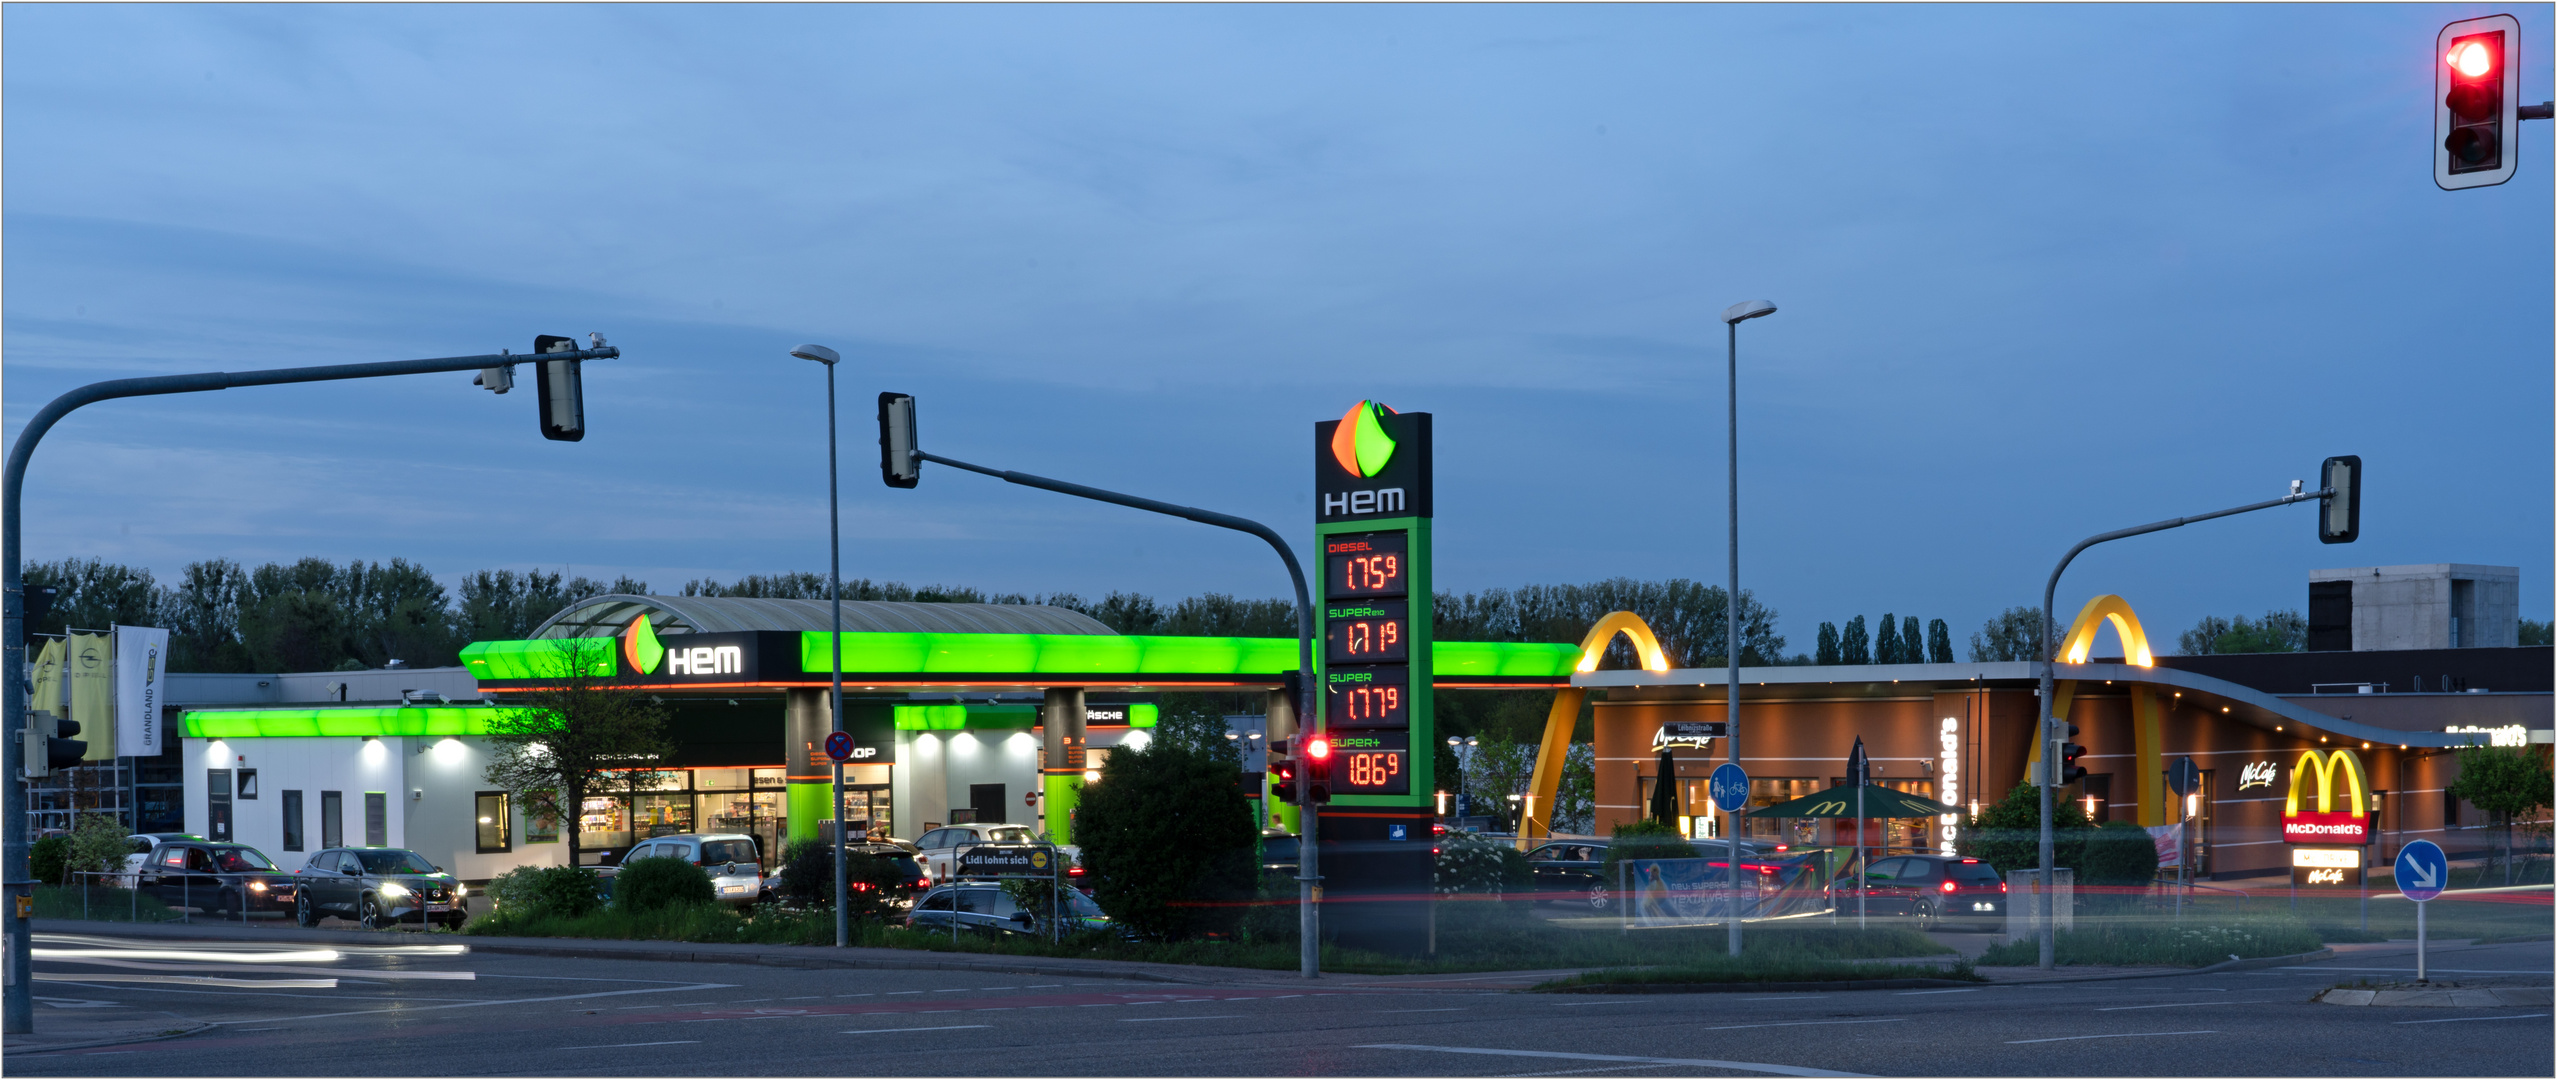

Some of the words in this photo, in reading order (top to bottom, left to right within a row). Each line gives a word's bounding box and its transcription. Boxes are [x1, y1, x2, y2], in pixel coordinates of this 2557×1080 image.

[1325, 487, 1405, 516] HEM
[1328, 542, 1372, 553] DIESEL
[1347, 555, 1397, 590] 1.759
[668, 645, 742, 675] HEM
[1329, 672, 1372, 683] SUPER
[1349, 687, 1398, 720] 1.779
[143, 688, 153, 746] GRANDLAND
[1085, 709, 1123, 720] ÄSCHE
[1677, 723, 1713, 732] Leibnizstraße
[1063, 736, 1072, 745] 3
[1330, 738, 1380, 748] SUPER+
[1349, 753, 1398, 786] 1.869
[2286, 823, 2363, 835] McDonald's
[965, 855, 983, 865] Lidl
[984, 855, 1009, 865] lohnt
[1010, 855, 1029, 865] sich
